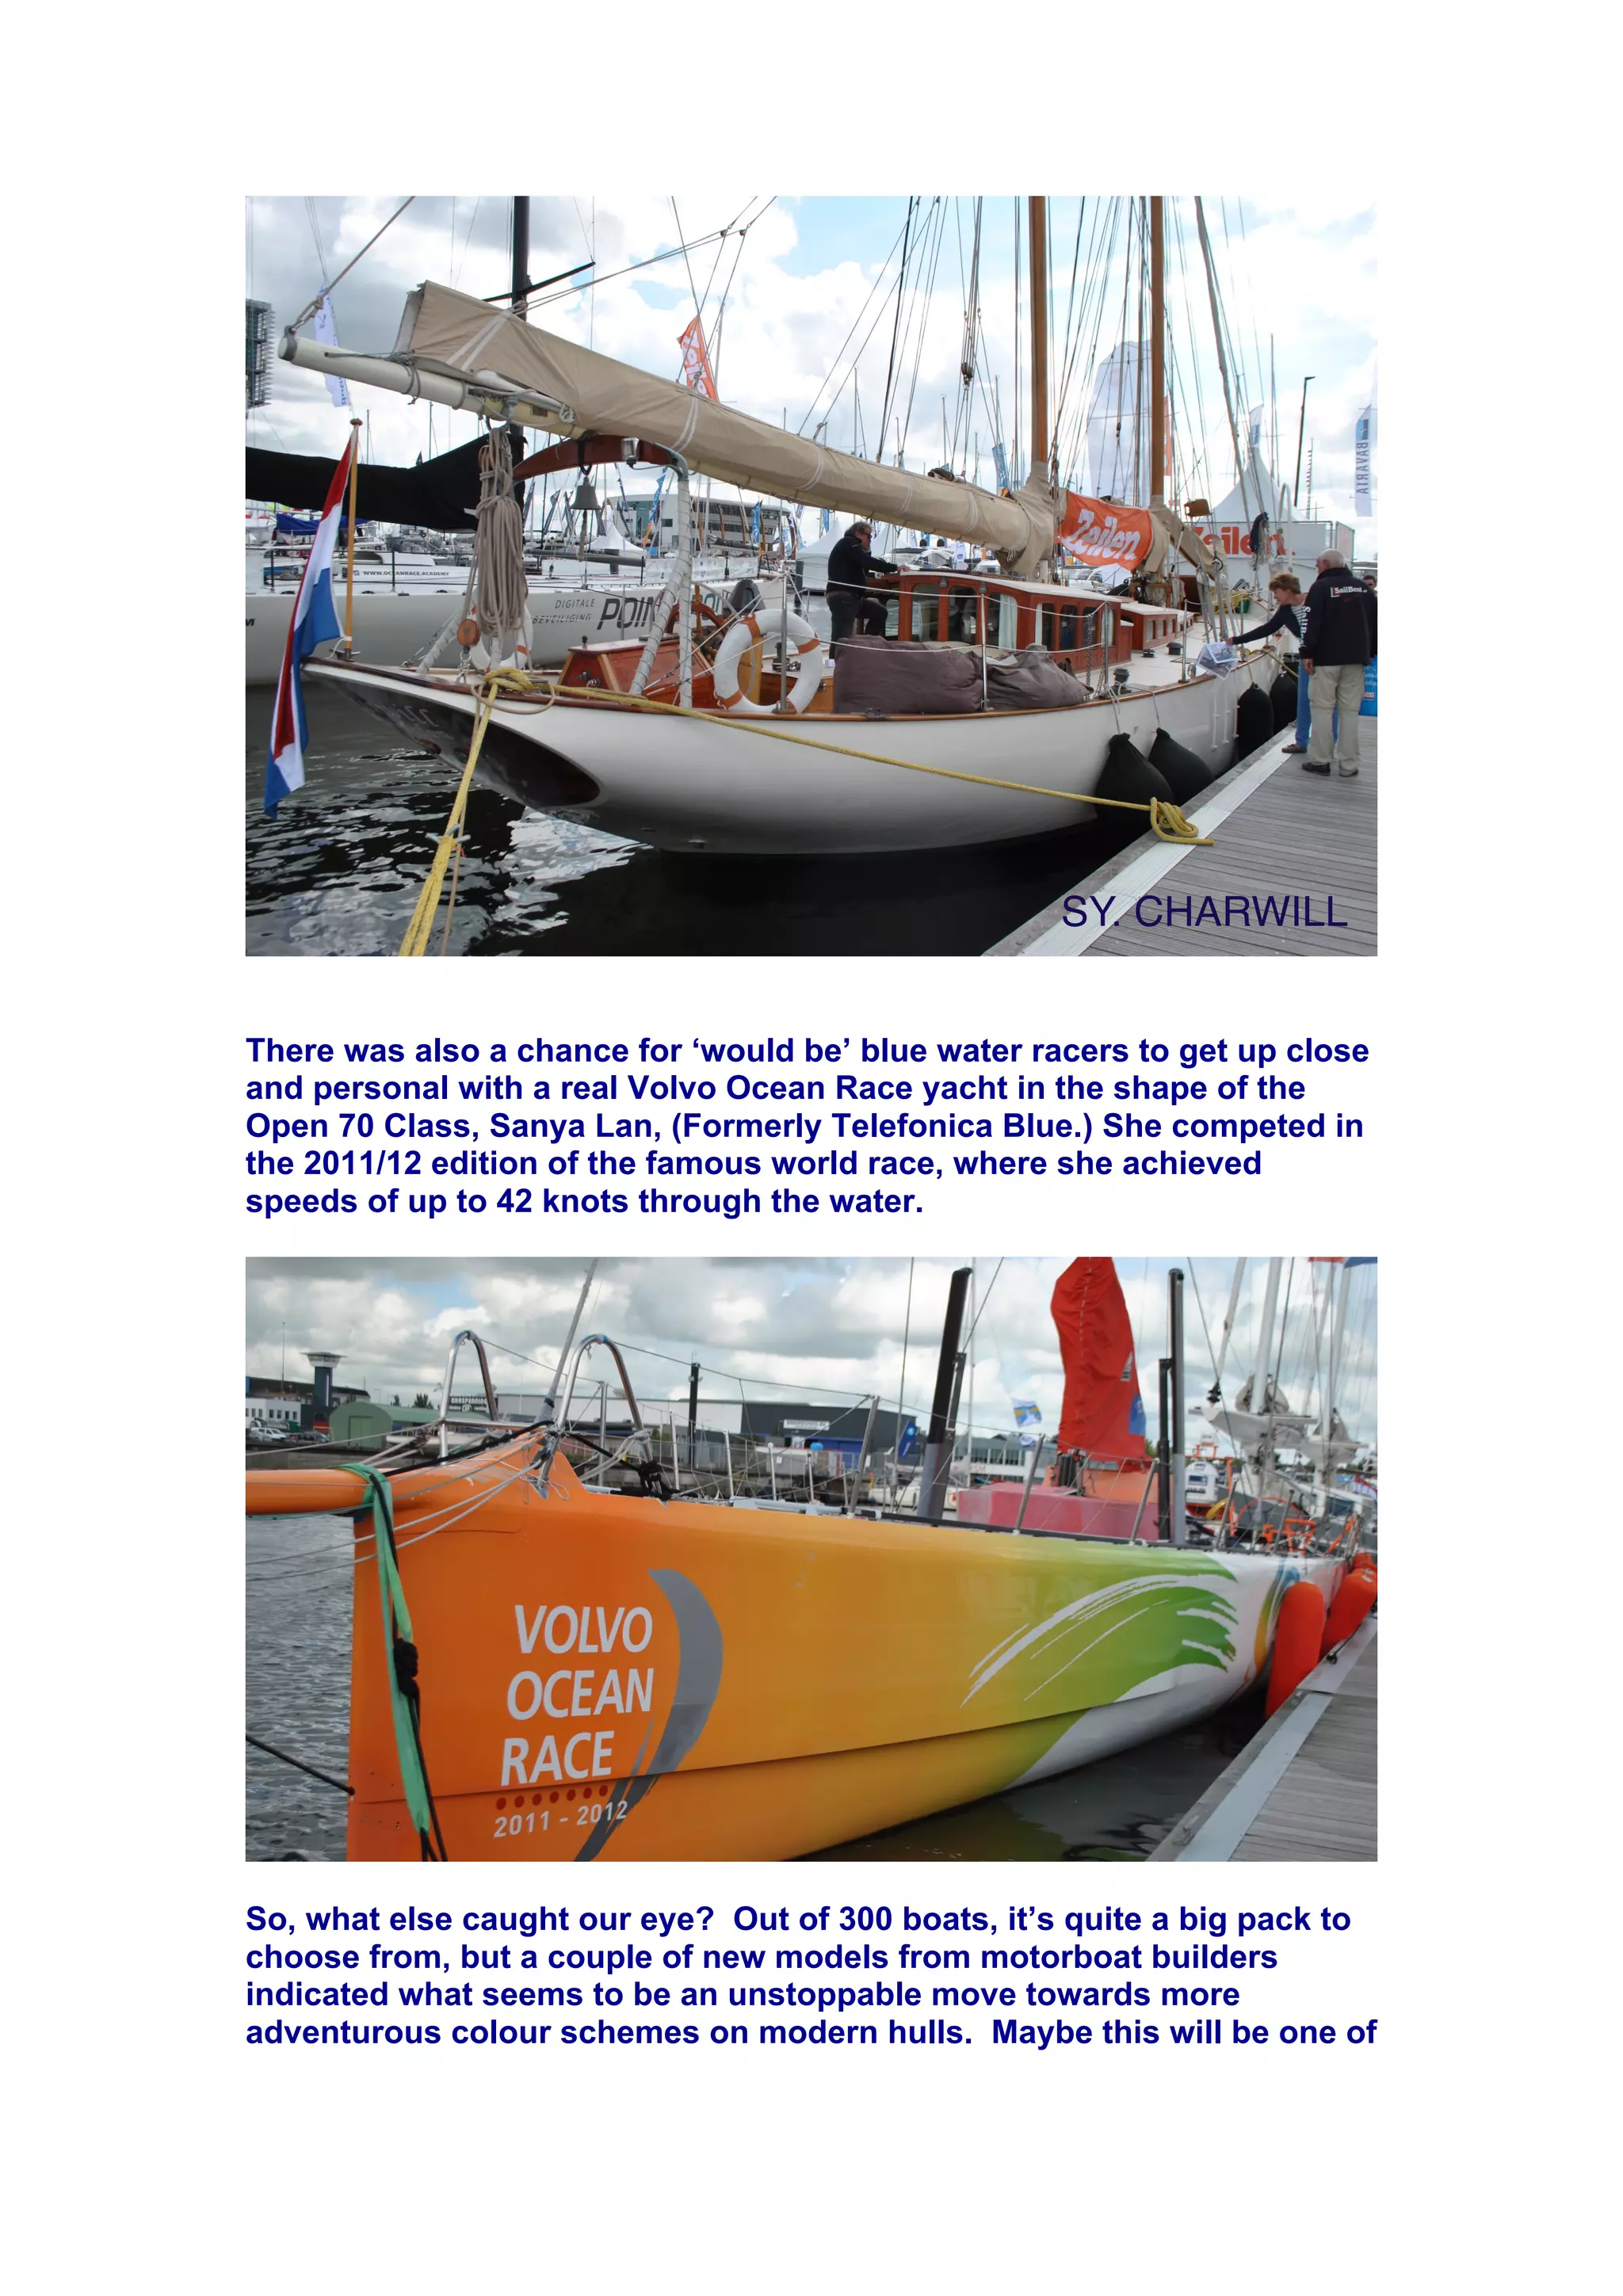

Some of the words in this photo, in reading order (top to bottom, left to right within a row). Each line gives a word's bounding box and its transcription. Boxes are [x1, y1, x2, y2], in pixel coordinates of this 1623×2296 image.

[1062, 509, 1140, 560] Zeilen
[556, 598, 595, 608] DIGITALE
[533, 614, 591, 624] BEVEILIGING
[246, 1038, 334, 1062] There
[344, 1044, 404, 1062] was
[416, 1038, 479, 1062] also
[491, 1044, 506, 1062] a
[518, 1038, 628, 1062] chance
[639, 1038, 682, 1062] for
[693, 1038, 793, 1062] ‘would
[806, 1038, 849, 1062] be’
[862, 1038, 926, 1062] blue
[937, 1039, 1022, 1062] water
[1033, 1044, 1128, 1062] racers
[1139, 1039, 1169, 1062] to
[1180, 1039, 1228, 1069] get
[1239, 1044, 1276, 1068] up
[1287, 1038, 1369, 1062] close
[246, 1075, 302, 1100] and
[315, 1075, 447, 1105] personal
[459, 1075, 521, 1099] with
[534, 1081, 550, 1099] a
[562, 1075, 617, 1100] real
[628, 1075, 716, 1099] Volvo
[727, 1075, 823, 1100] Ocean
[837, 1075, 912, 1099] Race
[922, 1075, 1007, 1106] yacht
[1019, 1075, 1044, 1099] in
[1056, 1075, 1103, 1099] the
[1114, 1075, 1207, 1105] shape
[1218, 1075, 1249, 1099] of
[1258, 1075, 1304, 1099] the
[246, 1113, 327, 1143] Open
[339, 1113, 373, 1137] 70
[385, 1113, 478, 1142] Class,
[491, 1113, 585, 1144] Sanya
[598, 1113, 660, 1142] Lan,
[673, 1113, 822, 1144] (Formerly
[832, 1113, 992, 1137] Telefonica
[1005, 1113, 1091, 1144] Blue.)
[1104, 1113, 1161, 1137] She
[1173, 1113, 1324, 1143] competed
[1338, 1113, 1362, 1137] in
[246, 1150, 293, 1175] the
[304, 1150, 421, 1175] 2011/12
[432, 1150, 537, 1175] edition
[548, 1150, 579, 1174] of
[588, 1150, 636, 1175] the
[646, 1150, 761, 1174] famous
[771, 1150, 857, 1174] world
[869, 1157, 941, 1179] race,
[953, 1150, 1046, 1174] where
[1058, 1150, 1112, 1175] she
[1124, 1150, 1260, 1175] achieved
[246, 1188, 357, 1219] speeds
[369, 1188, 399, 1212] of
[410, 1195, 446, 1219] up
[457, 1189, 487, 1212] to
[497, 1188, 531, 1212] 42
[544, 1188, 628, 1212] knots
[639, 1188, 760, 1219] through
[771, 1188, 819, 1212] the
[830, 1189, 922, 1212] water.
[514, 1605, 653, 1654] VOLVO
[507, 1668, 654, 1720] OCEAN
[501, 1730, 615, 1786] RACE
[494, 1811, 549, 1837] 2011
[576, 1800, 628, 1825] 2012
[246, 1906, 294, 1935] So,
[306, 1906, 380, 1930] what
[390, 1906, 452, 1931] else
[464, 1906, 569, 1937] caught
[579, 1913, 632, 1931] our
[641, 1906, 713, 1937] eye?
[735, 1906, 789, 1931] Out
[800, 1906, 831, 1931] of
[840, 1906, 892, 1931] 300
[904, 1906, 996, 1935] boats,
[1010, 1906, 1053, 1931] it’s
[1065, 1906, 1141, 1936] quite
[1152, 1913, 1168, 1930] a
[1181, 1906, 1226, 1937] big
[1239, 1906, 1311, 1936] pack
[1321, 1907, 1350, 1931] to
[246, 1944, 359, 1968] choose
[369, 1944, 449, 1973] from,
[462, 1944, 510, 1968] but
[521, 1951, 537, 1968] a
[548, 1944, 651, 1974] couple
[663, 1944, 693, 1968] of
[705, 1951, 766, 1968] new
[777, 1944, 888, 1968] models
[899, 1944, 969, 1968] from
[982, 1944, 1142, 1968] motorboat
[1153, 1944, 1277, 1968] builders
[248, 1981, 388, 2005] indicated
[399, 1981, 472, 2006] what
[483, 1988, 582, 2006] seems
[594, 1982, 623, 2006] to
[635, 1981, 670, 2005] be
[682, 1988, 716, 2005] an
[730, 1981, 921, 2012] unstoppable
[933, 1988, 1015, 2005] move
[1026, 1981, 1150, 2005] towards
[1163, 1988, 1239, 2005] more
[246, 2019, 441, 2043] adventurous
[453, 2019, 552, 2043] colour
[561, 2019, 699, 2043] schemes
[711, 2026, 747, 2043] on
[760, 2019, 876, 2043] modern
[890, 2019, 971, 2043] hulls.
[994, 2019, 1092, 2050] Maybe
[1102, 2019, 1159, 2043] this
[1170, 2019, 1220, 2043] will
[1233, 2019, 1268, 2043] be
[1280, 2026, 1335, 2043] one
[1347, 2019, 1378, 2043] of
